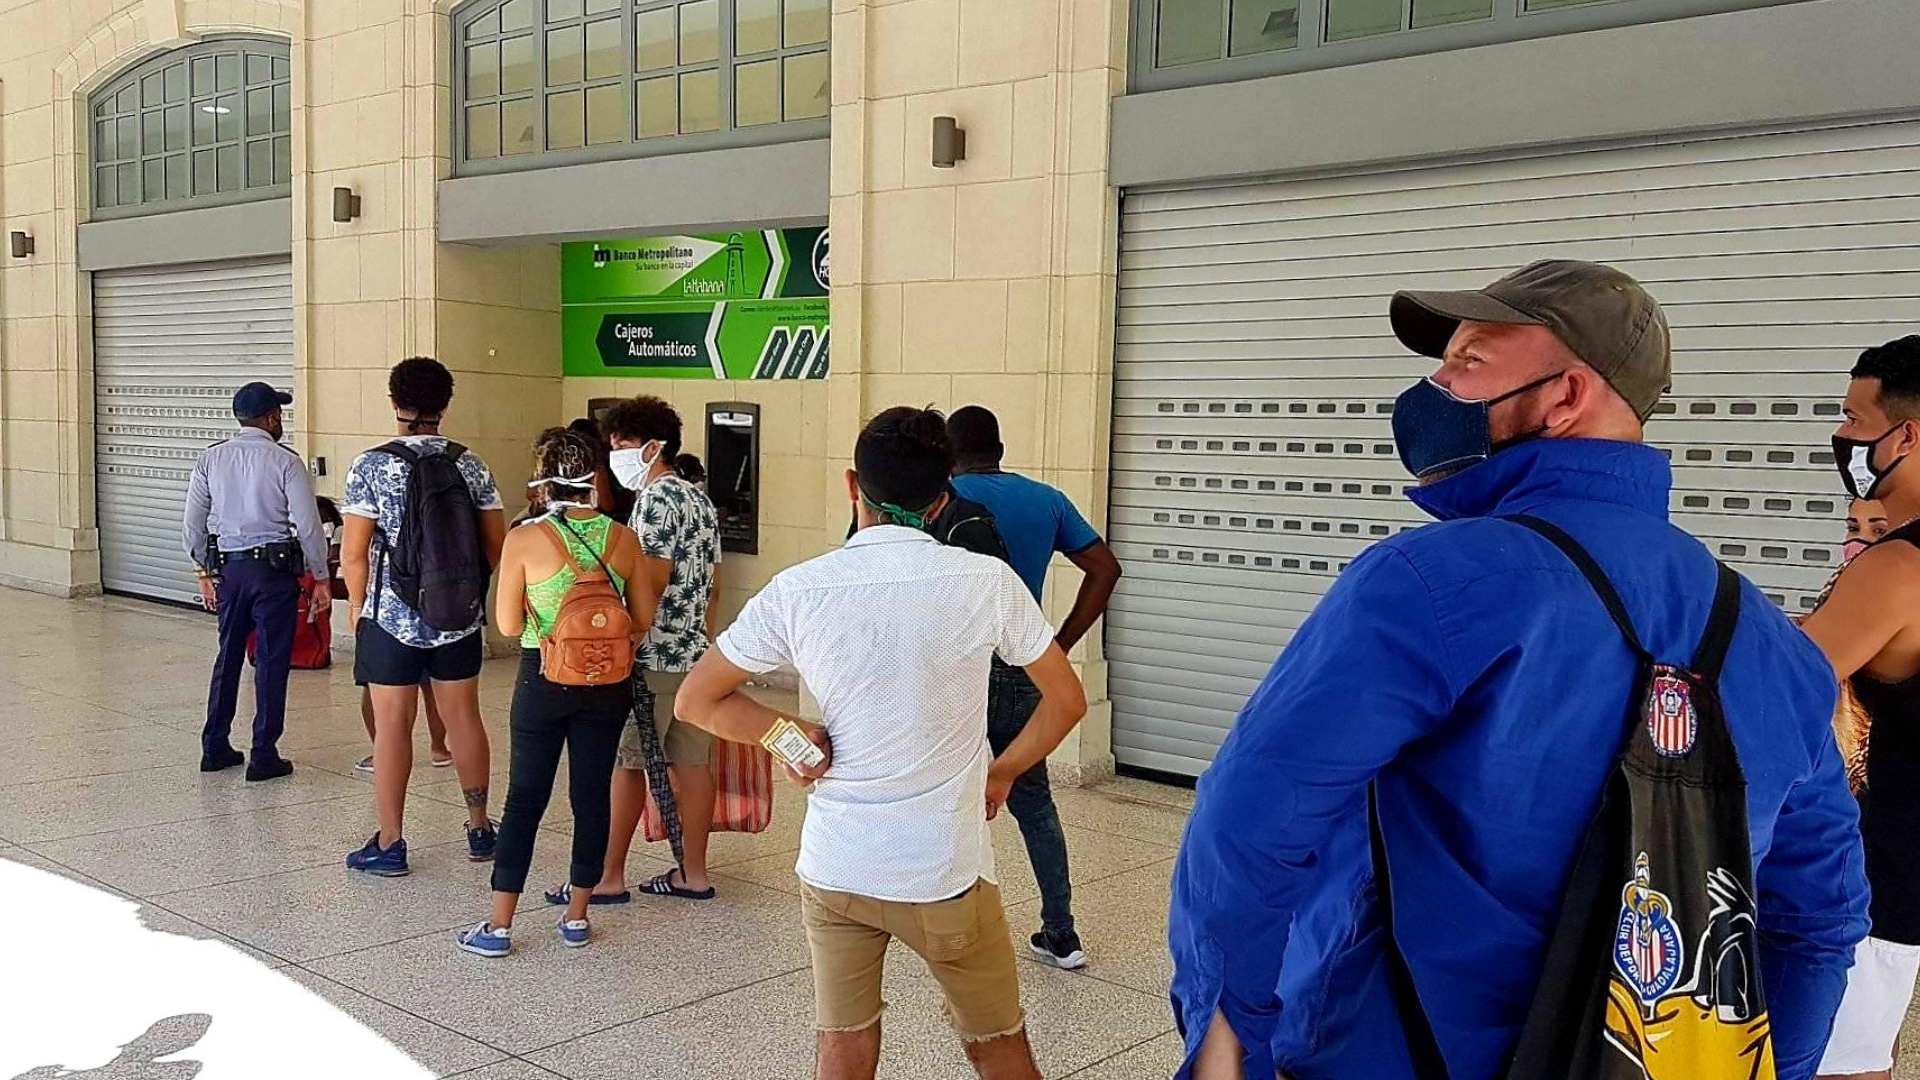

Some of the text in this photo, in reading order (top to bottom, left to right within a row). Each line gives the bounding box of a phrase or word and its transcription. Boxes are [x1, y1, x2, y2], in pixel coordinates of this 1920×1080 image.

[614, 246, 694, 261] Banco Metropolitano
[661, 262, 668, 270] en
[675, 260, 694, 270] capital
[614, 323, 697, 357] Cajeros Automáticos
[1619, 912, 1635, 940] CLUB
